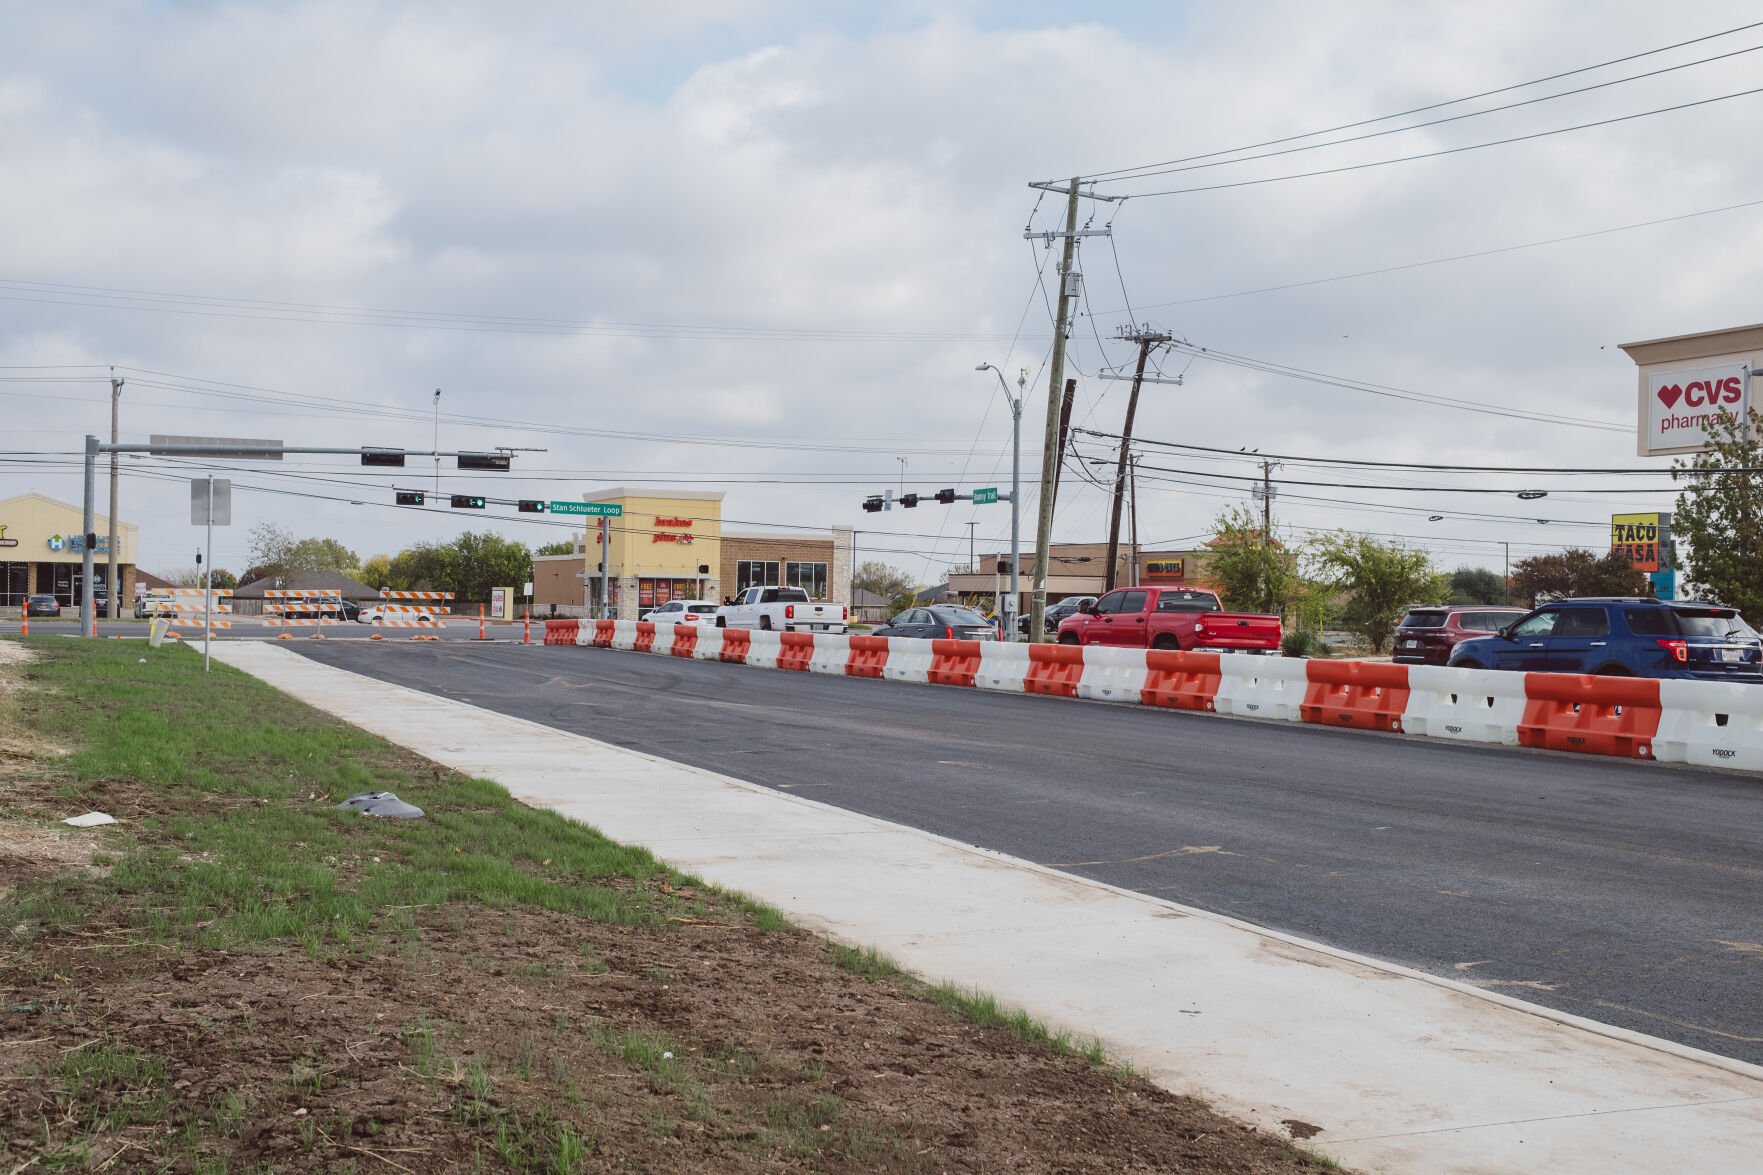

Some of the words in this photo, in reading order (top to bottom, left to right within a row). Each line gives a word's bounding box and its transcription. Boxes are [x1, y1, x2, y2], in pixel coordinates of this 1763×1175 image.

[1684, 377, 1742, 407] CVS
[569, 504, 601, 513] Schlueter
[603, 506, 620, 515] Loop
[1615, 522, 1657, 542] TACO
[1712, 749, 1736, 757] YODOCK
